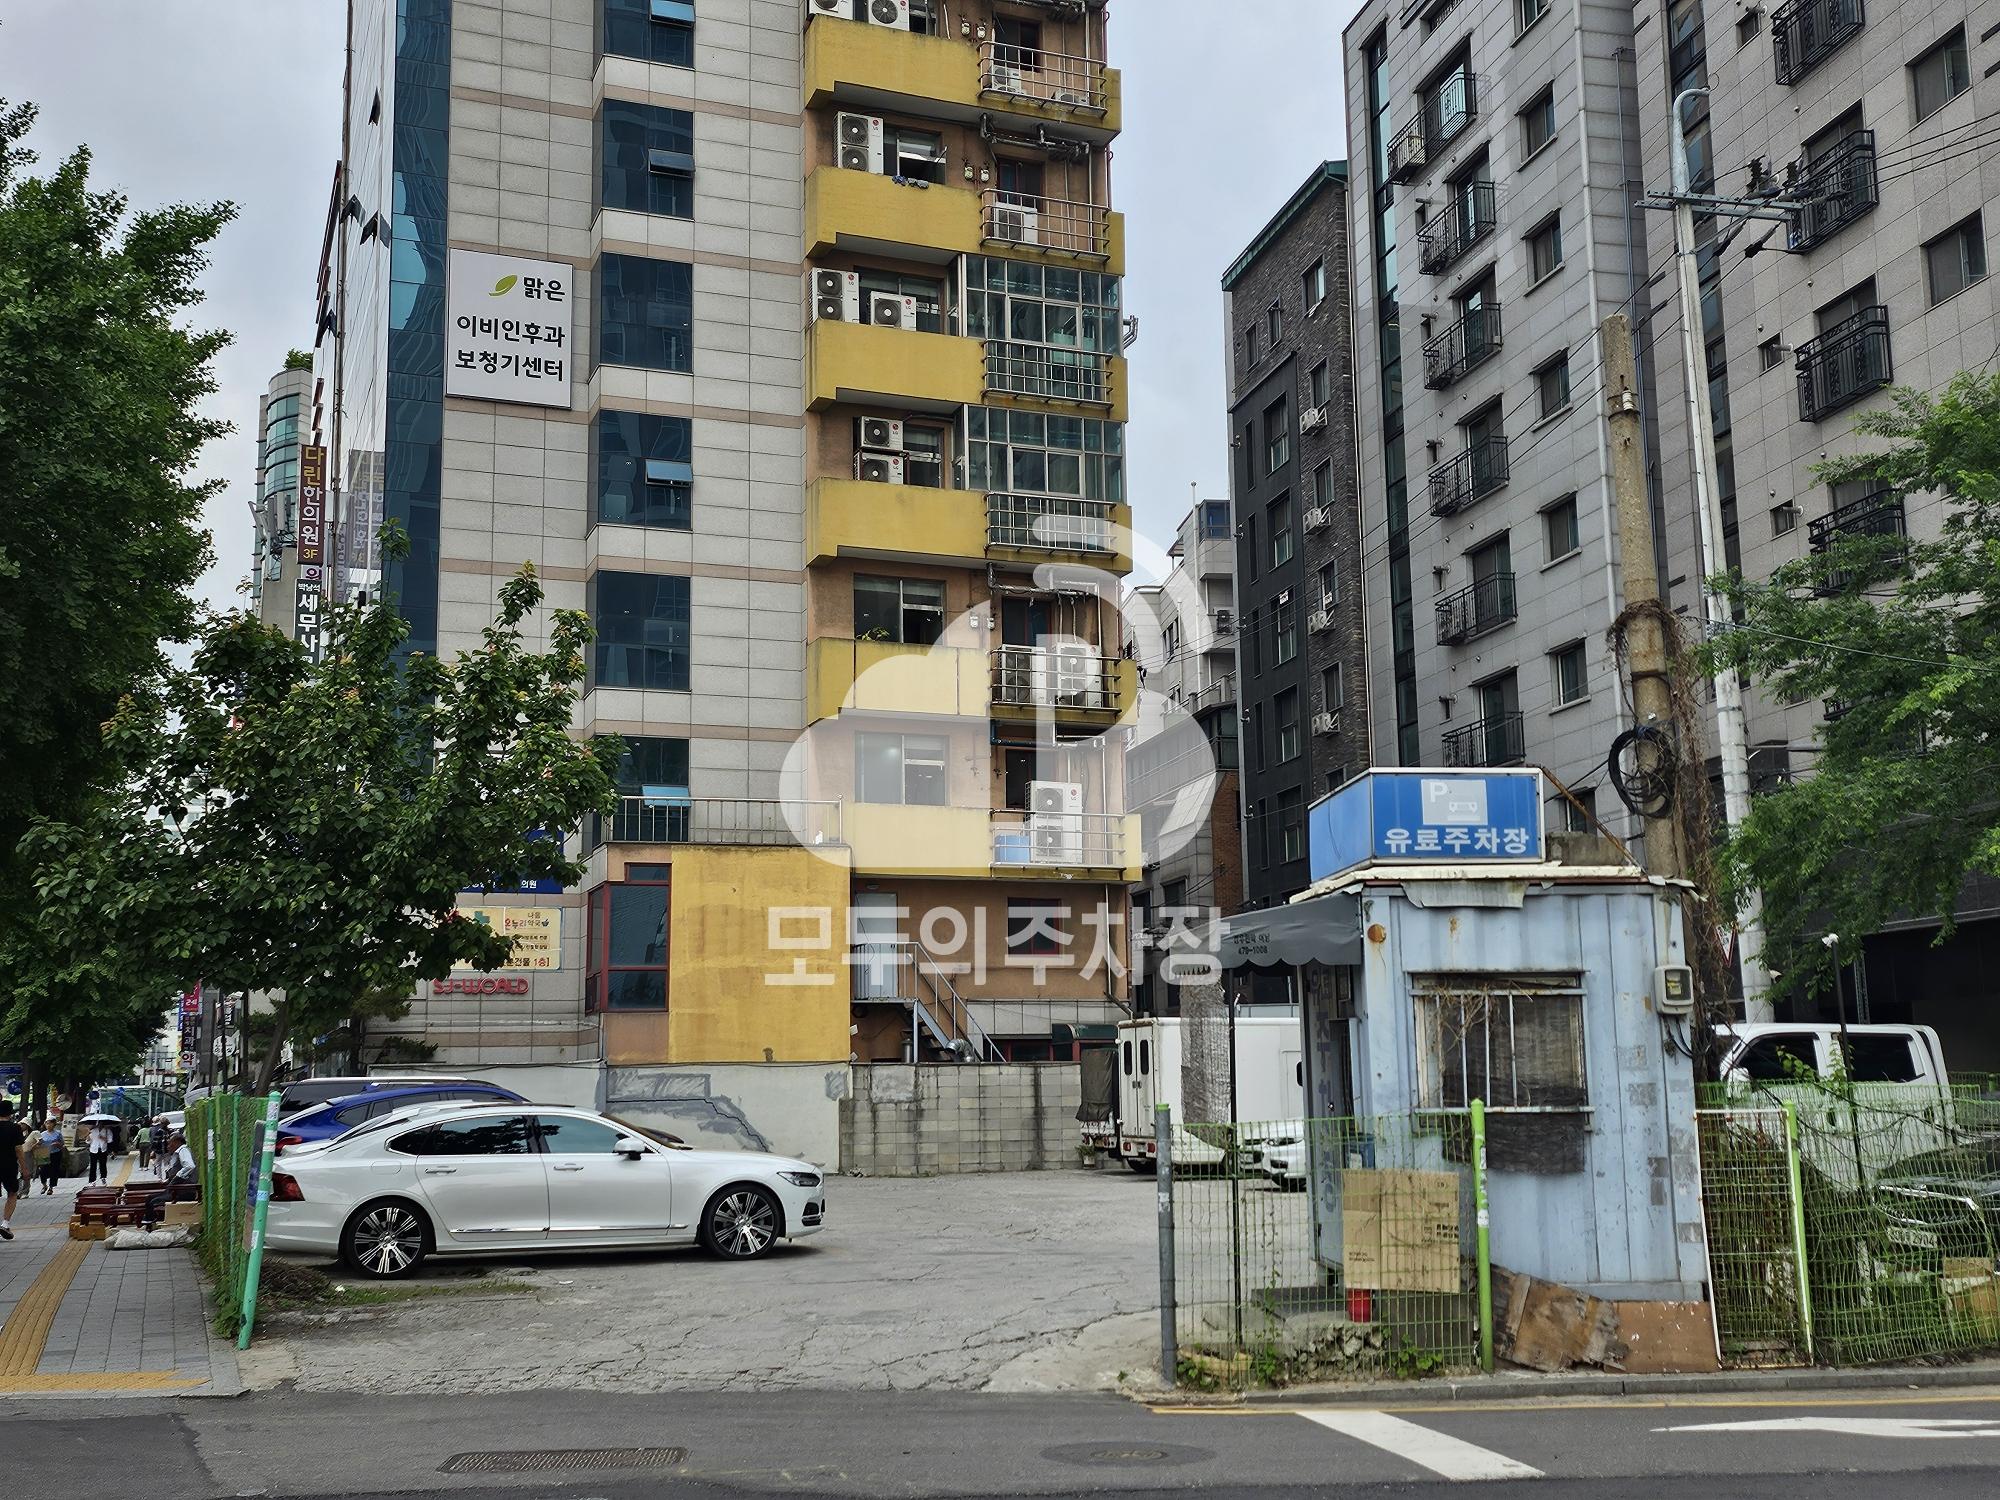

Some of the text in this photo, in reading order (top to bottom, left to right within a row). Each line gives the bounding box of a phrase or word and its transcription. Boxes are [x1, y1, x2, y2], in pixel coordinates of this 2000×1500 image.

[523, 277, 565, 302] 맑은
[456, 316, 565, 348] 이비인후과
[455, 349, 563, 382] 보청기센터
[301, 446, 324, 546] 다린한의원
[303, 548, 319, 559] 3F
[1430, 782, 1448, 803] P
[1384, 826, 1529, 854] 유료주차장
